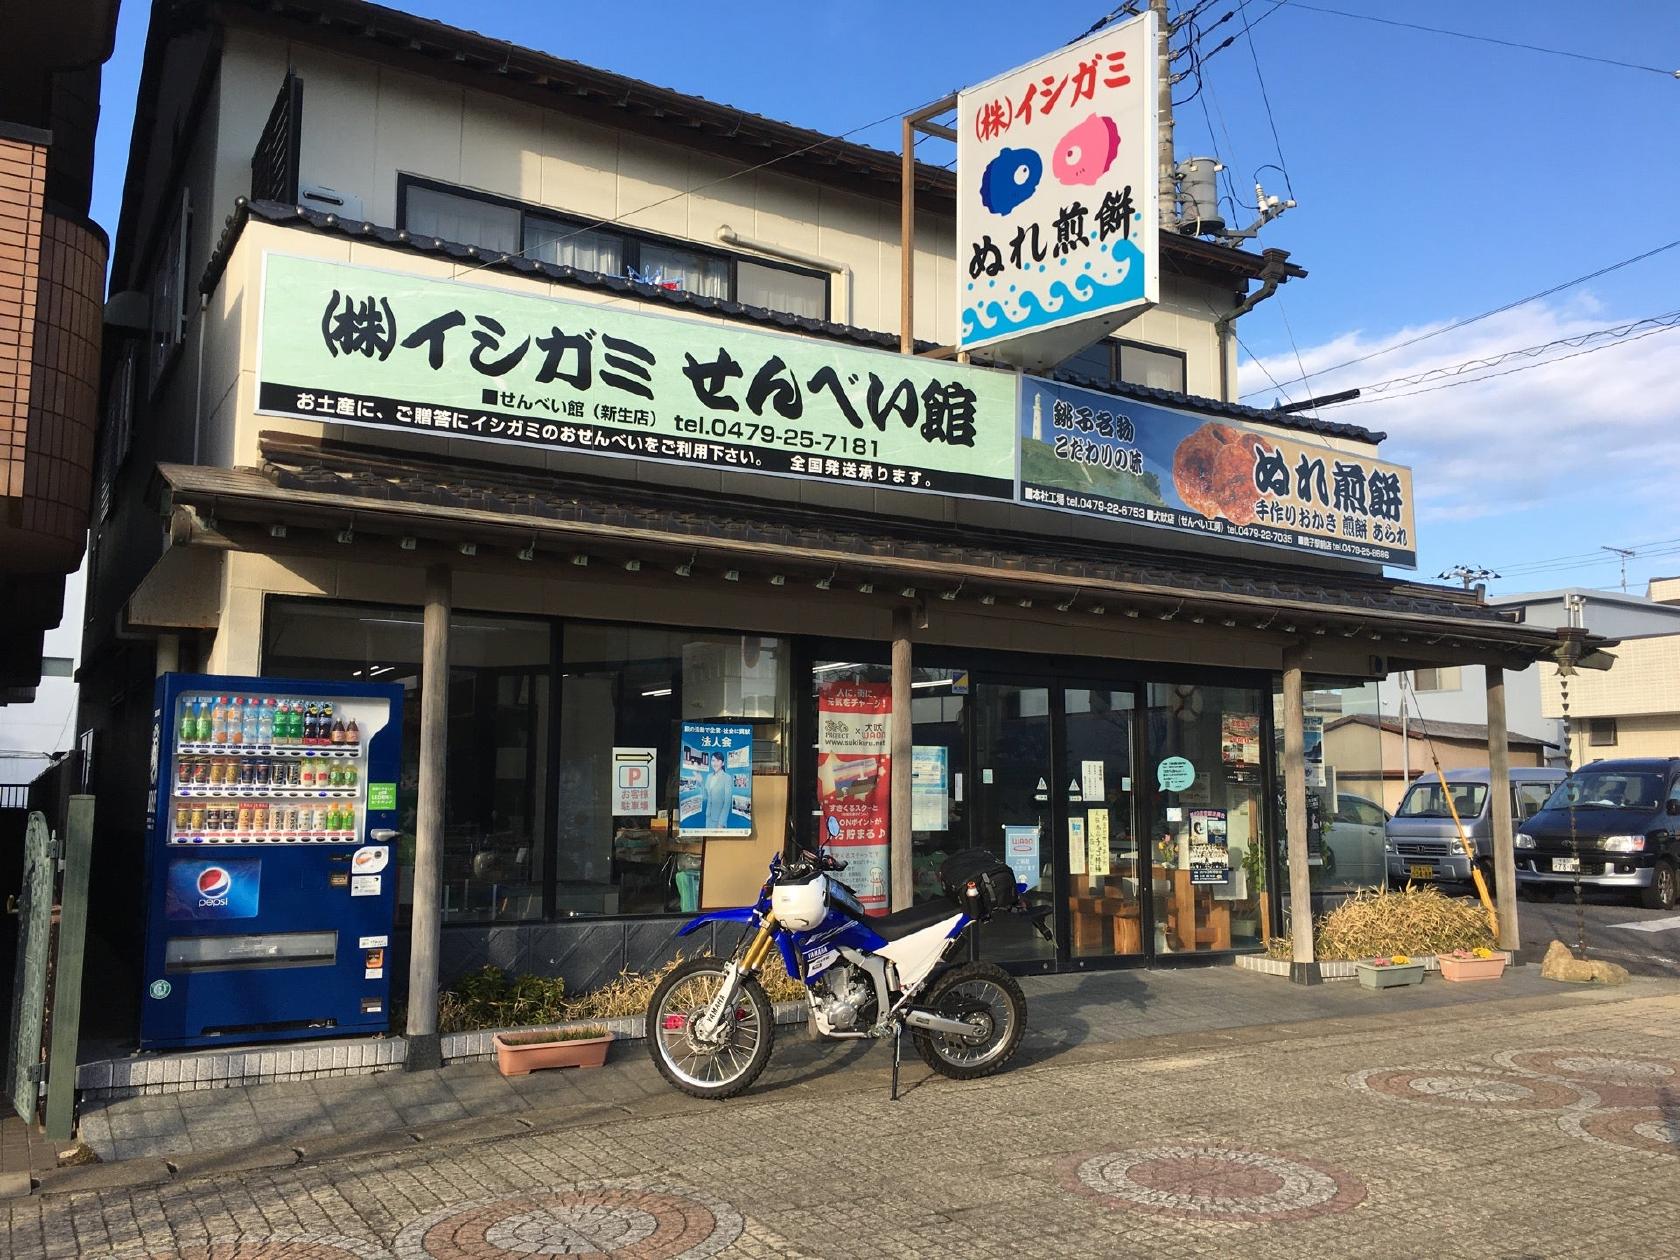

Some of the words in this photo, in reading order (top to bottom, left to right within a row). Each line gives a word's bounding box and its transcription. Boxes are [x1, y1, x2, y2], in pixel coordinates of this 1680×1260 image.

[975, 51, 1131, 144] (株)イシガミ
[969, 186, 1136, 280] ぬれ煎餅
[682, 347, 977, 448] せんべい館
[674, 414, 879, 458] tel.0479-25-7181
[1055, 434, 1143, 476] こだわりの味
[789, 455, 932, 488] 全国発送承ります。
[1254, 444, 1403, 523] ぬれ煎餅
[1066, 496, 1146, 519] tel.0479-22-6753
[1227, 525, 1293, 544] tel.0479-22-7035
[1342, 515, 1368, 539] 煎餅
[1372, 522, 1408, 547] あられ
[701, 735, 732, 748] 法人会
[628, 767, 642, 787] P
[620, 800, 649, 811] 駐車場
[621, 790, 649, 800] お客様
[198, 897, 229, 908] pepsi
[807, 946, 828, 960] YAMAHA
[706, 994, 726, 1023] YAMAHA
